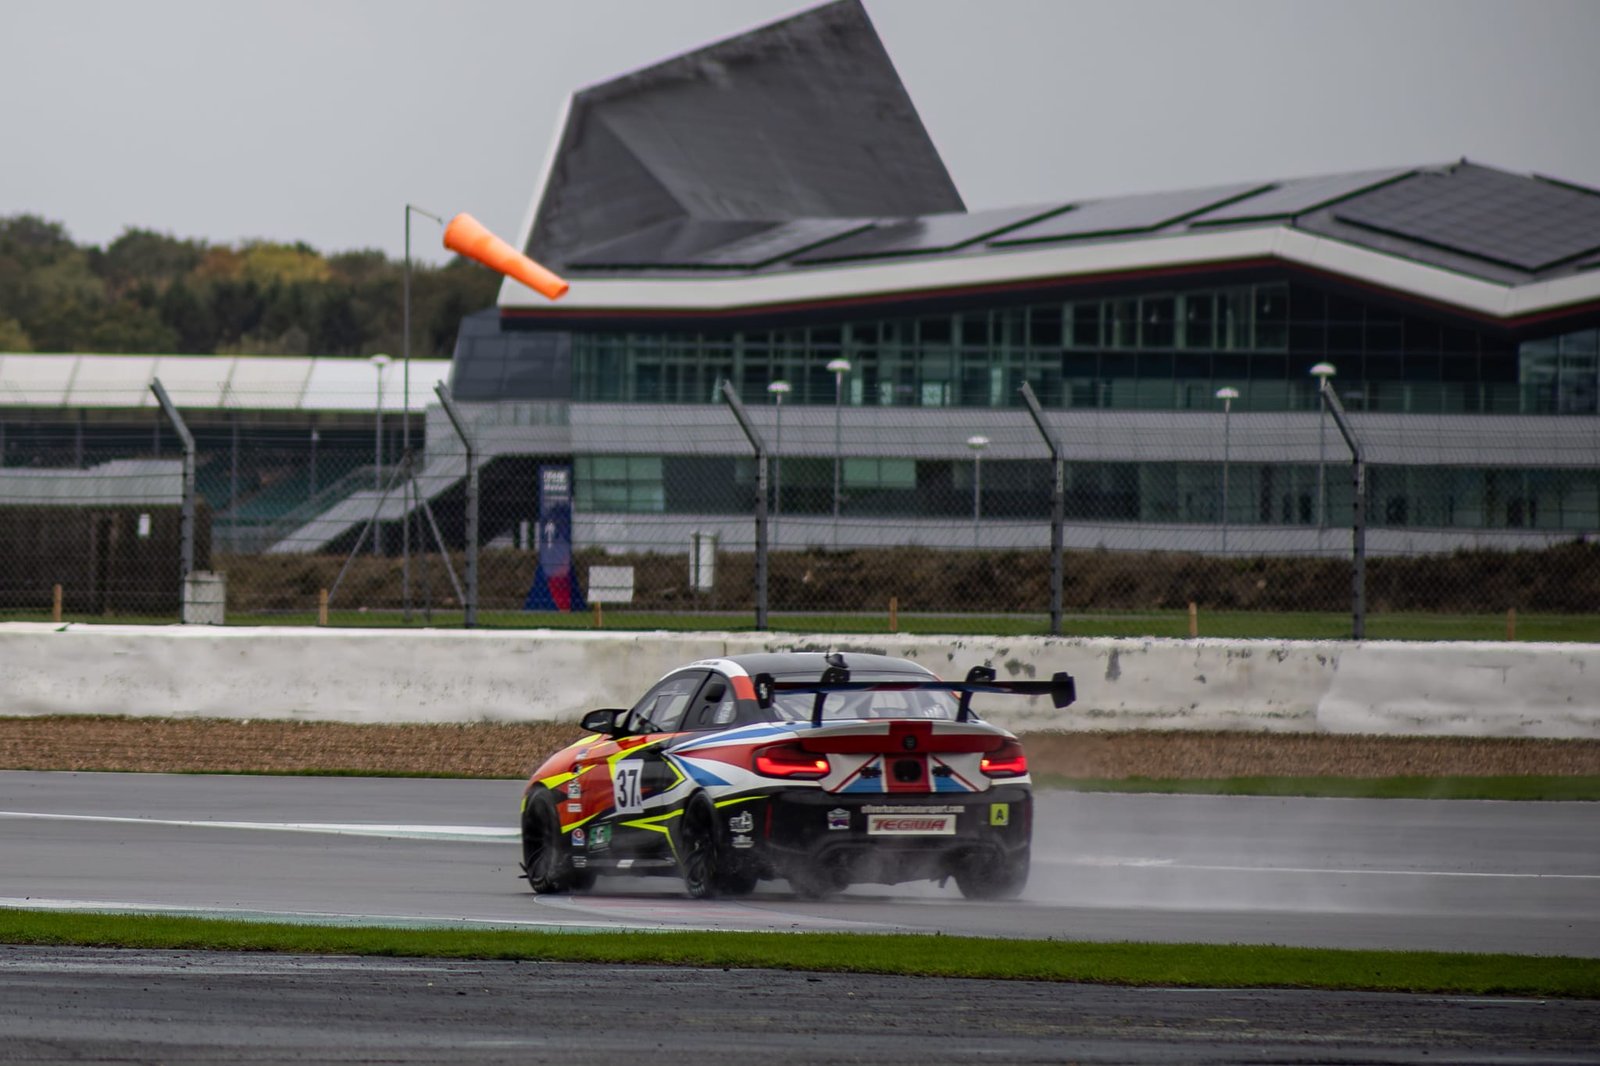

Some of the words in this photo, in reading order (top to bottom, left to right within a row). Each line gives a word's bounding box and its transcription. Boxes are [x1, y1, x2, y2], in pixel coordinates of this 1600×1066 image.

[616, 769, 638, 808] 37
[995, 808, 1004, 821] A
[873, 818, 947, 831] TEGIWA
